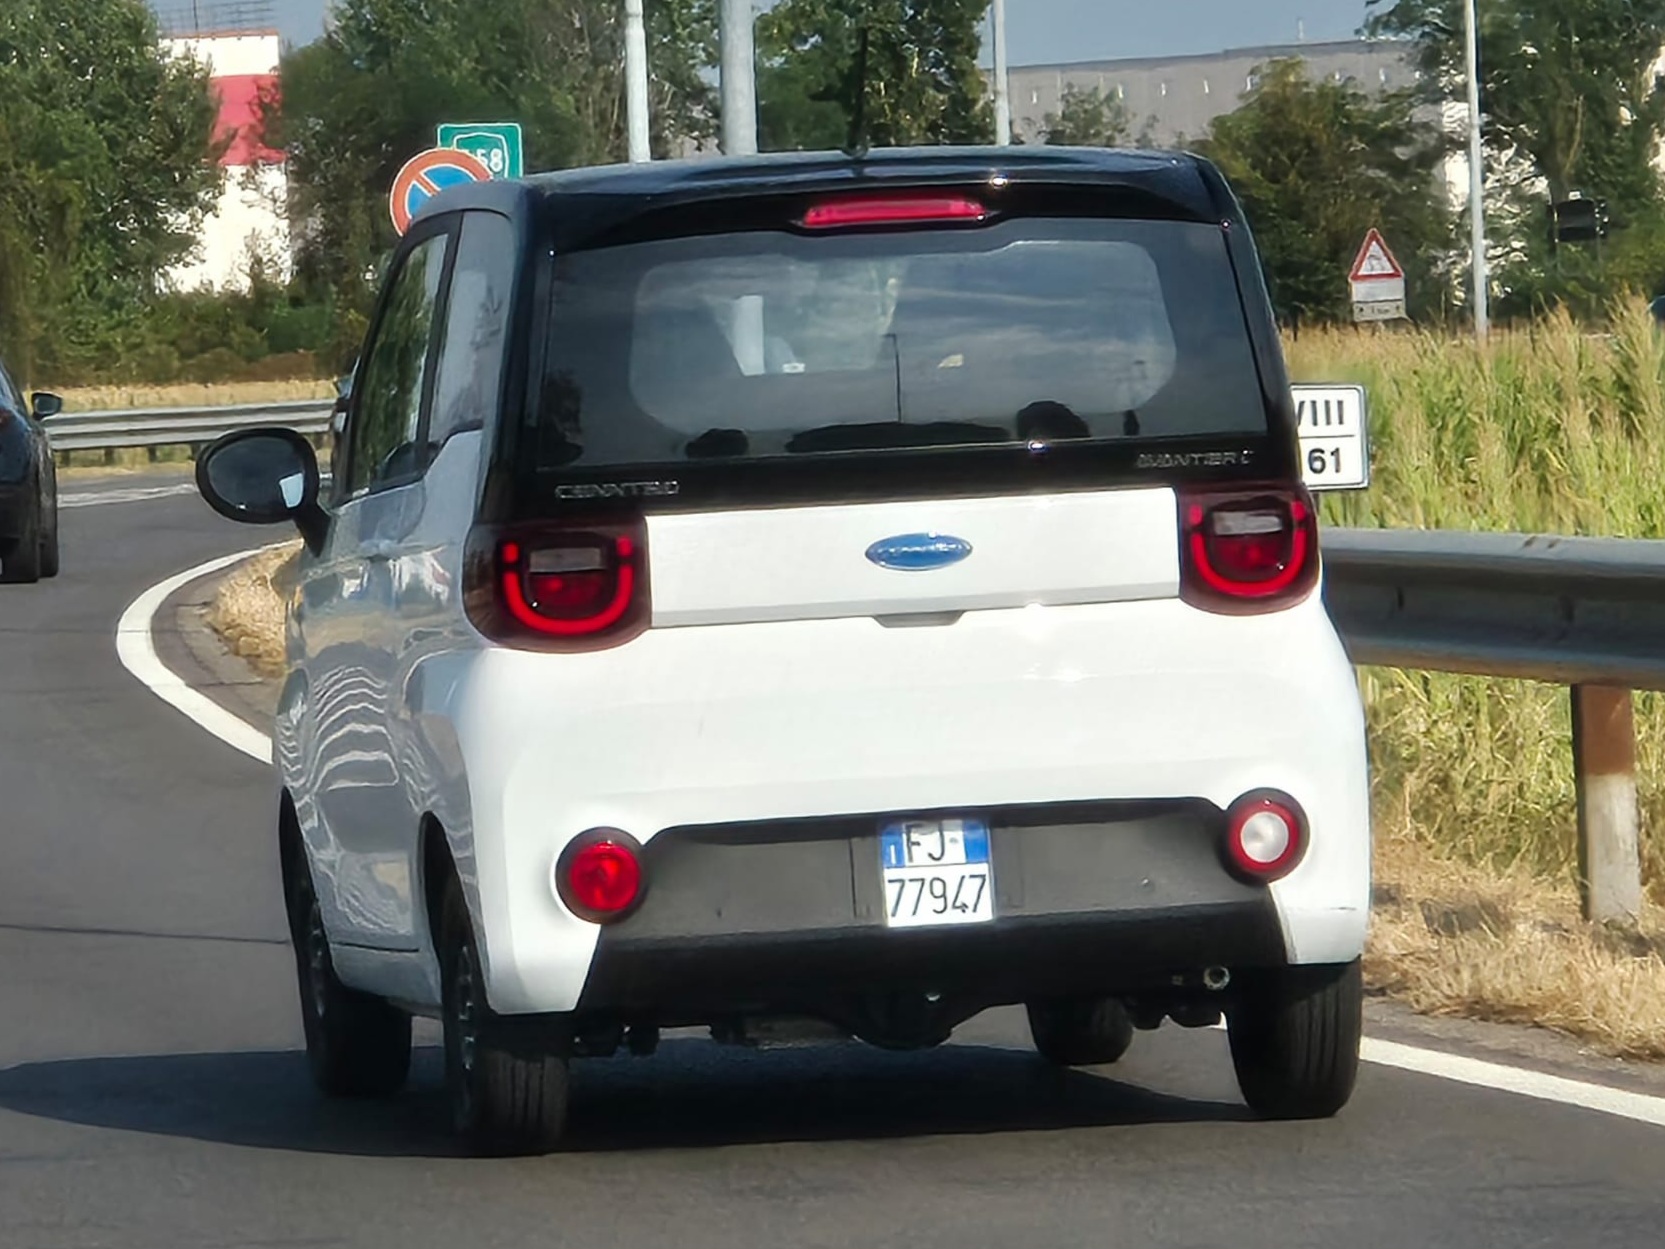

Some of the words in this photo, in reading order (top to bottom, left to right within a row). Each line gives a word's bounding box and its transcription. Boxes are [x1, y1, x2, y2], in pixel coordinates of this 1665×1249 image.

[1308, 447, 1341, 474] 61
[904, 822, 946, 863] FJ
[887, 873, 987, 918] 77947
